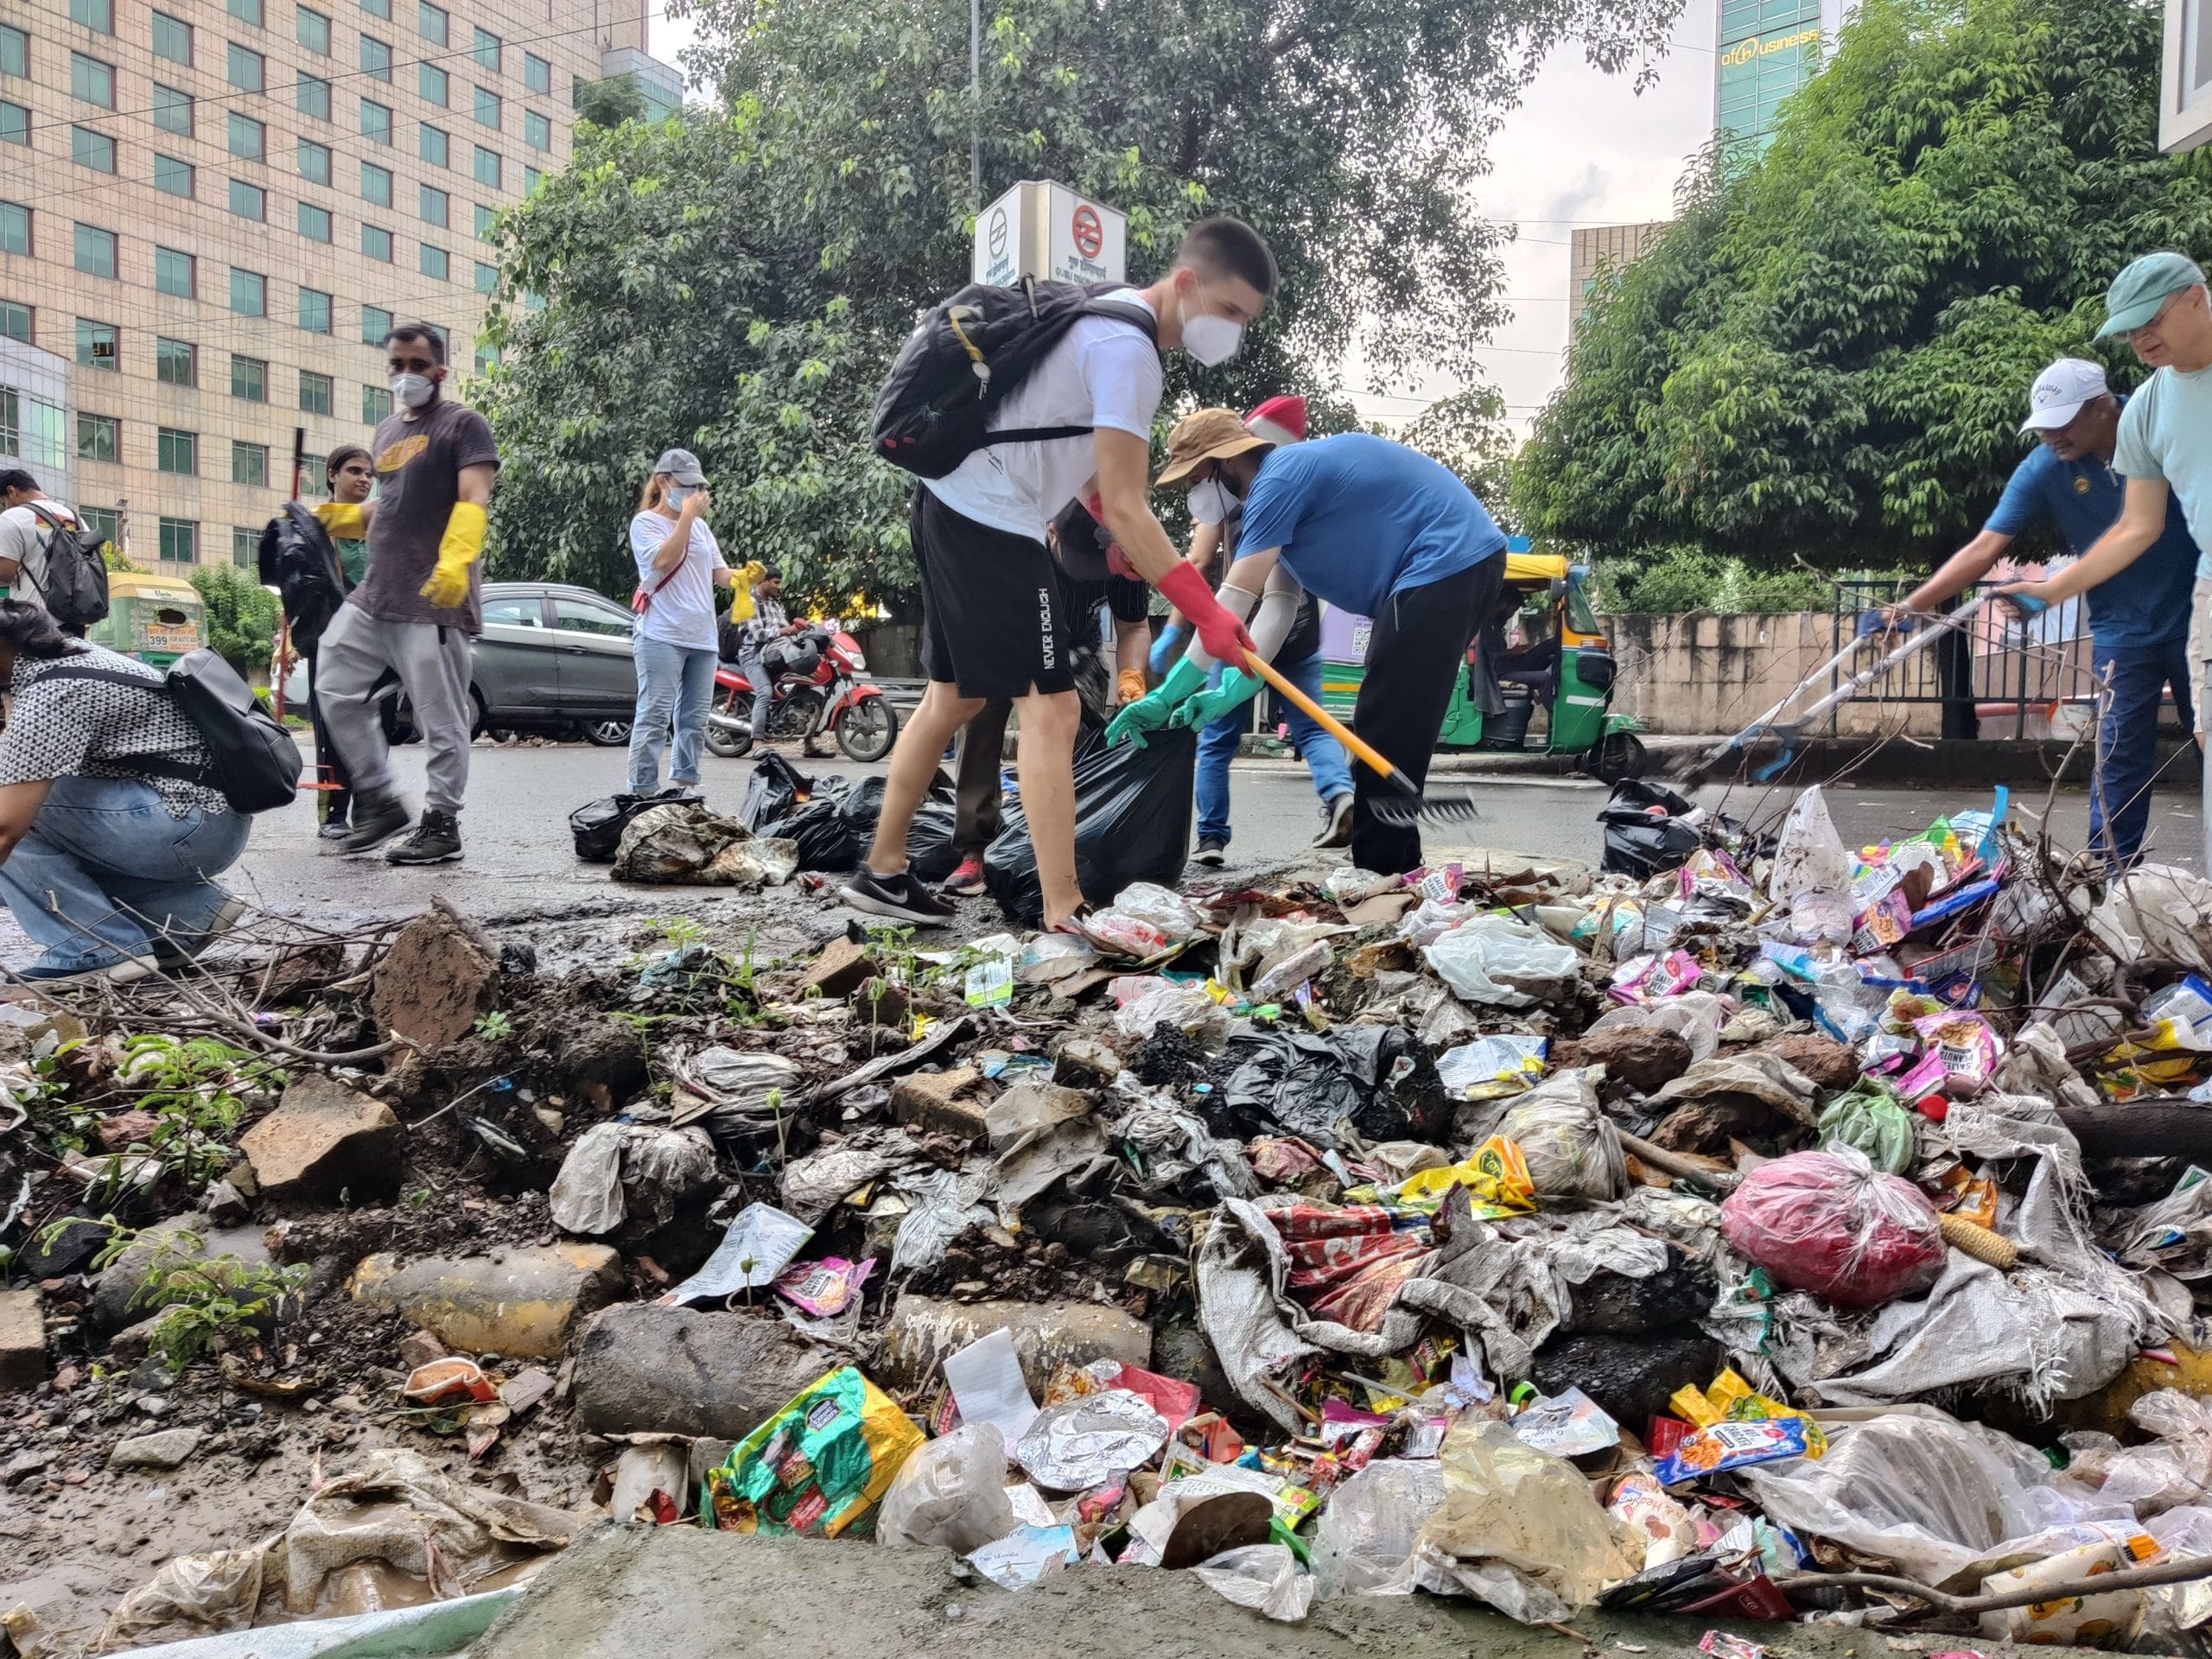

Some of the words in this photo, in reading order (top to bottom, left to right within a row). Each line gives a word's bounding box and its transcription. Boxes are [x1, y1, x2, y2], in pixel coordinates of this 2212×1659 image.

[1039, 588, 1052, 632] ENOUGH
[149, 636, 168, 645] 399
[1042, 634, 1055, 670] NEVER
[1427, 878, 1441, 899] PEANUTS
[1433, 875, 1447, 894] SALTED
[1940, 1051, 1974, 1062] PEANUTS
[1723, 1426, 1752, 1447] CRACKER
